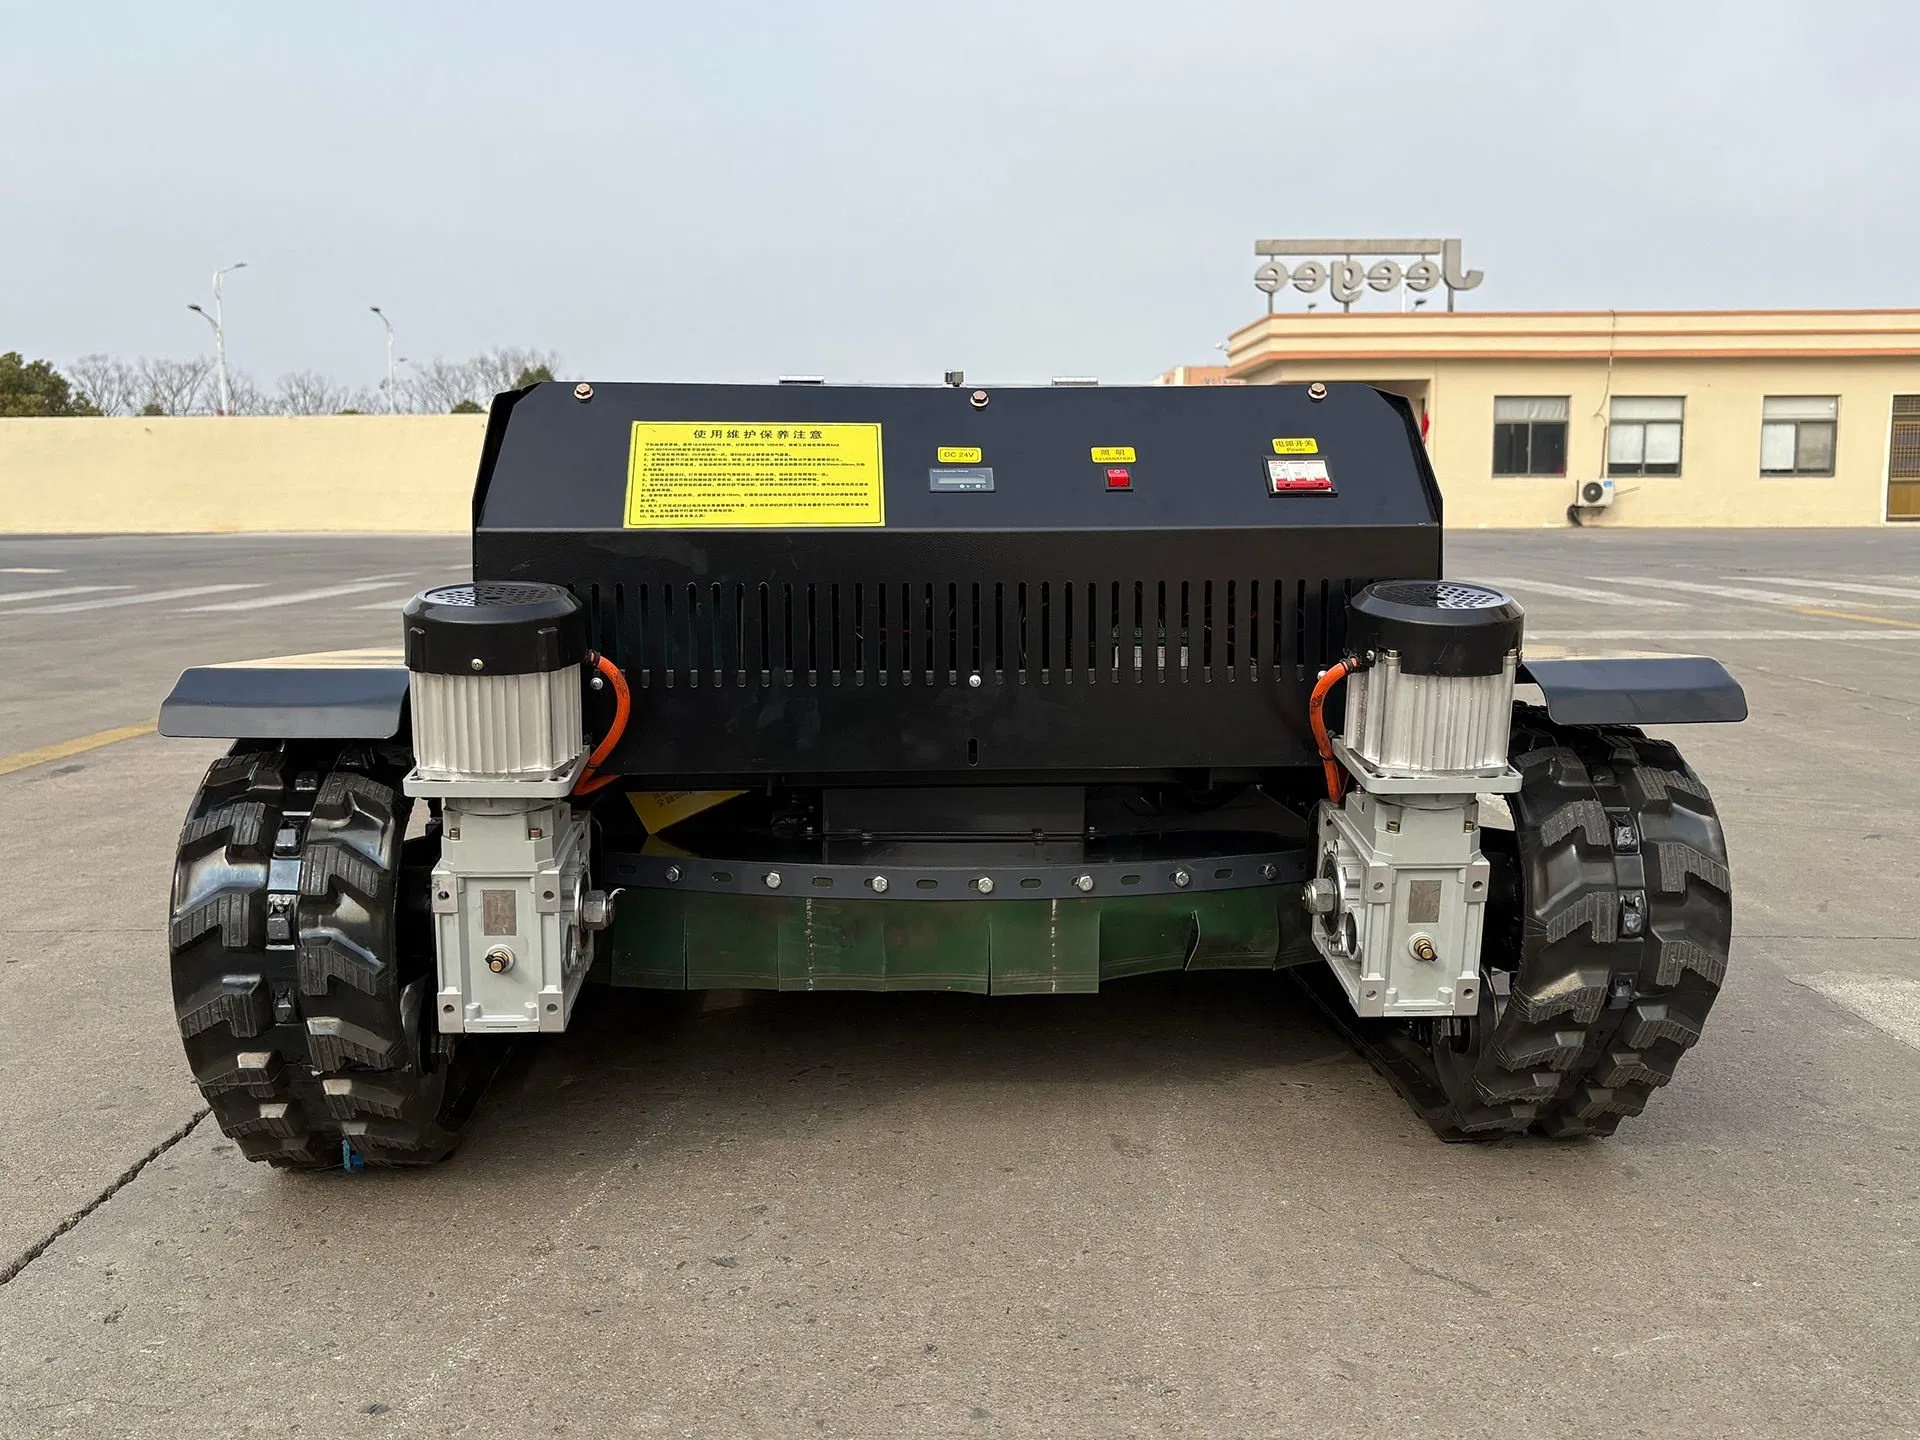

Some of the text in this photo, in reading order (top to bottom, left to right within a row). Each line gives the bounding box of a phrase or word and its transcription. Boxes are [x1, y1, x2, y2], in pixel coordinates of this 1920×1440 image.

[693, 429, 823, 440] 使用维护保养注意
